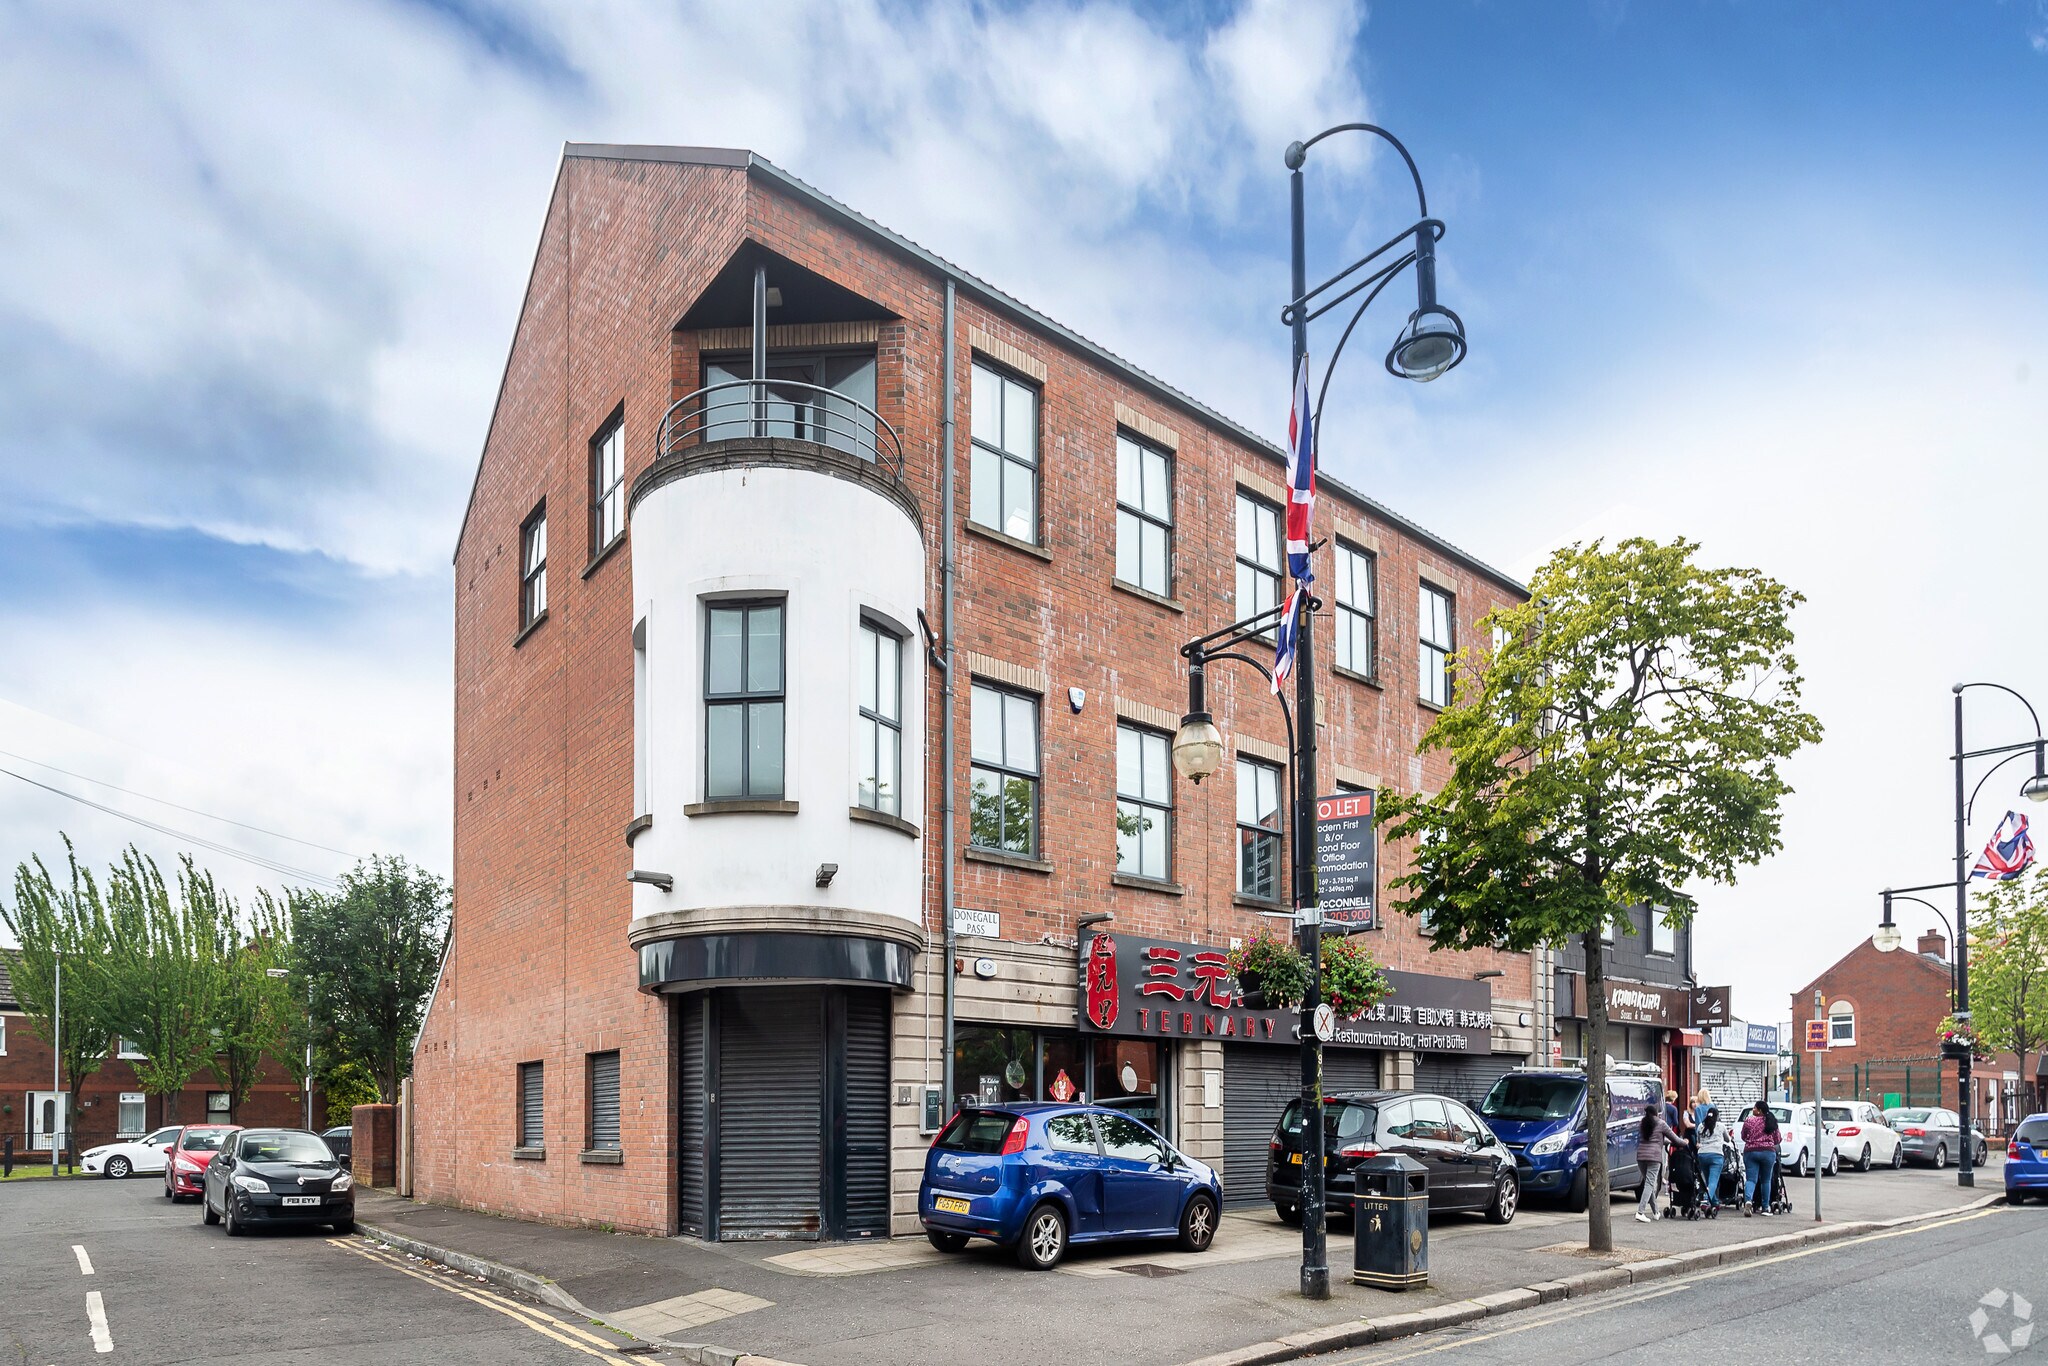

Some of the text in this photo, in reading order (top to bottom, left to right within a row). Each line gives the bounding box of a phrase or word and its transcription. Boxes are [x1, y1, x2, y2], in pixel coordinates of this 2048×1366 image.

[1317, 799, 1361, 818] O LET
[1317, 821, 1359, 832] odern First
[1325, 833, 1344, 842] &/or
[1317, 841, 1361, 853] cond Floor
[1322, 853, 1346, 862] Office
[1318, 861, 1368, 873] mmodation
[954, 910, 998, 924] DONEGALL
[1351, 909, 1371, 921] 900
[966, 924, 986, 934] PASS
[1143, 946, 1244, 1010] 三元
[1611, 988, 1661, 1011] KAMAKURA
[1392, 1005, 1412, 1024] 川菜
[1418, 1008, 1454, 1028] 自助火锅
[1140, 1008, 1276, 1039] TERNARY
[1335, 1028, 1381, 1044] Restaurant
[1382, 1031, 1398, 1046] and
[1400, 1032, 1416, 1049] Bar,
[1417, 1034, 1432, 1048] Hot
[1432, 1034, 1445, 1048] Pot
[1446, 1035, 1468, 1050] Buffet
[1364, 1202, 1389, 1211] LITTER
